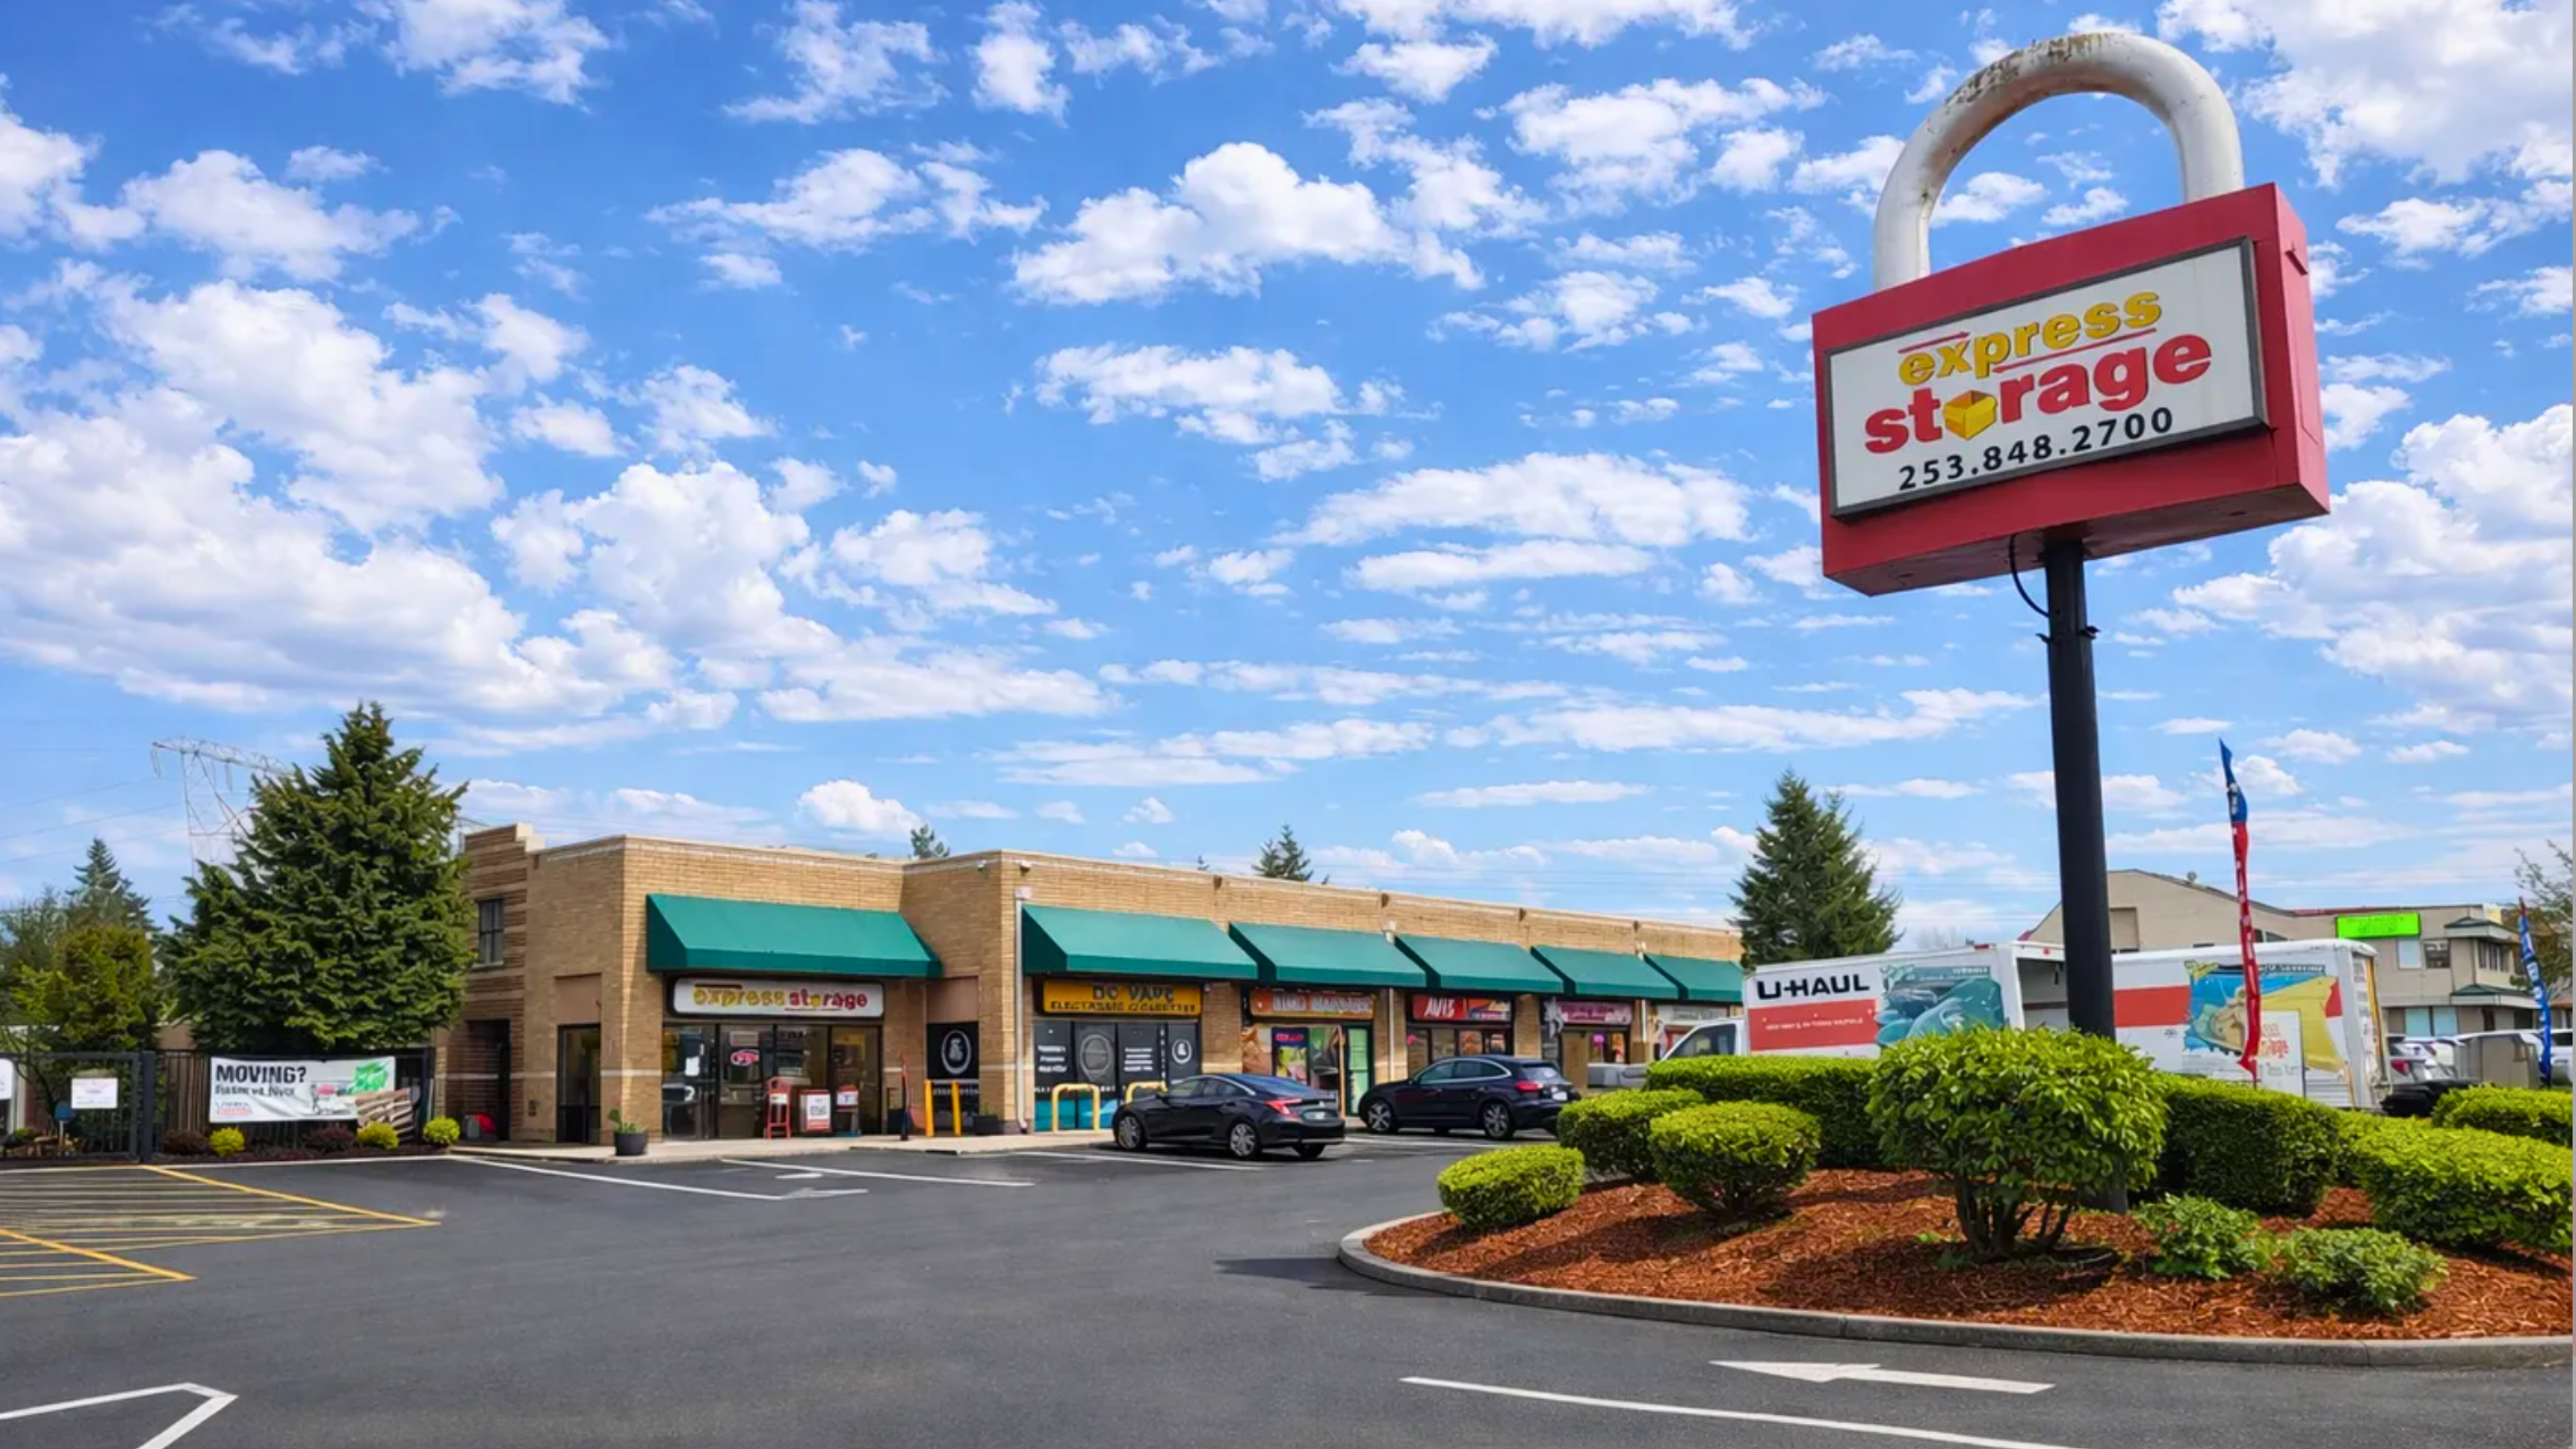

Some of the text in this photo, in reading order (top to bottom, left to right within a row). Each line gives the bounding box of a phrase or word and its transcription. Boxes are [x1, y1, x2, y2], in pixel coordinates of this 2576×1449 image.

[1898, 291, 2163, 386] express
[1898, 406, 2174, 491] 253.848.2700
[693, 988, 868, 1010] express storage
[1757, 974, 1870, 1000] U-HAUL
[1424, 996, 1455, 1019] AVIS
[215, 1065, 307, 1084] MOVING?
